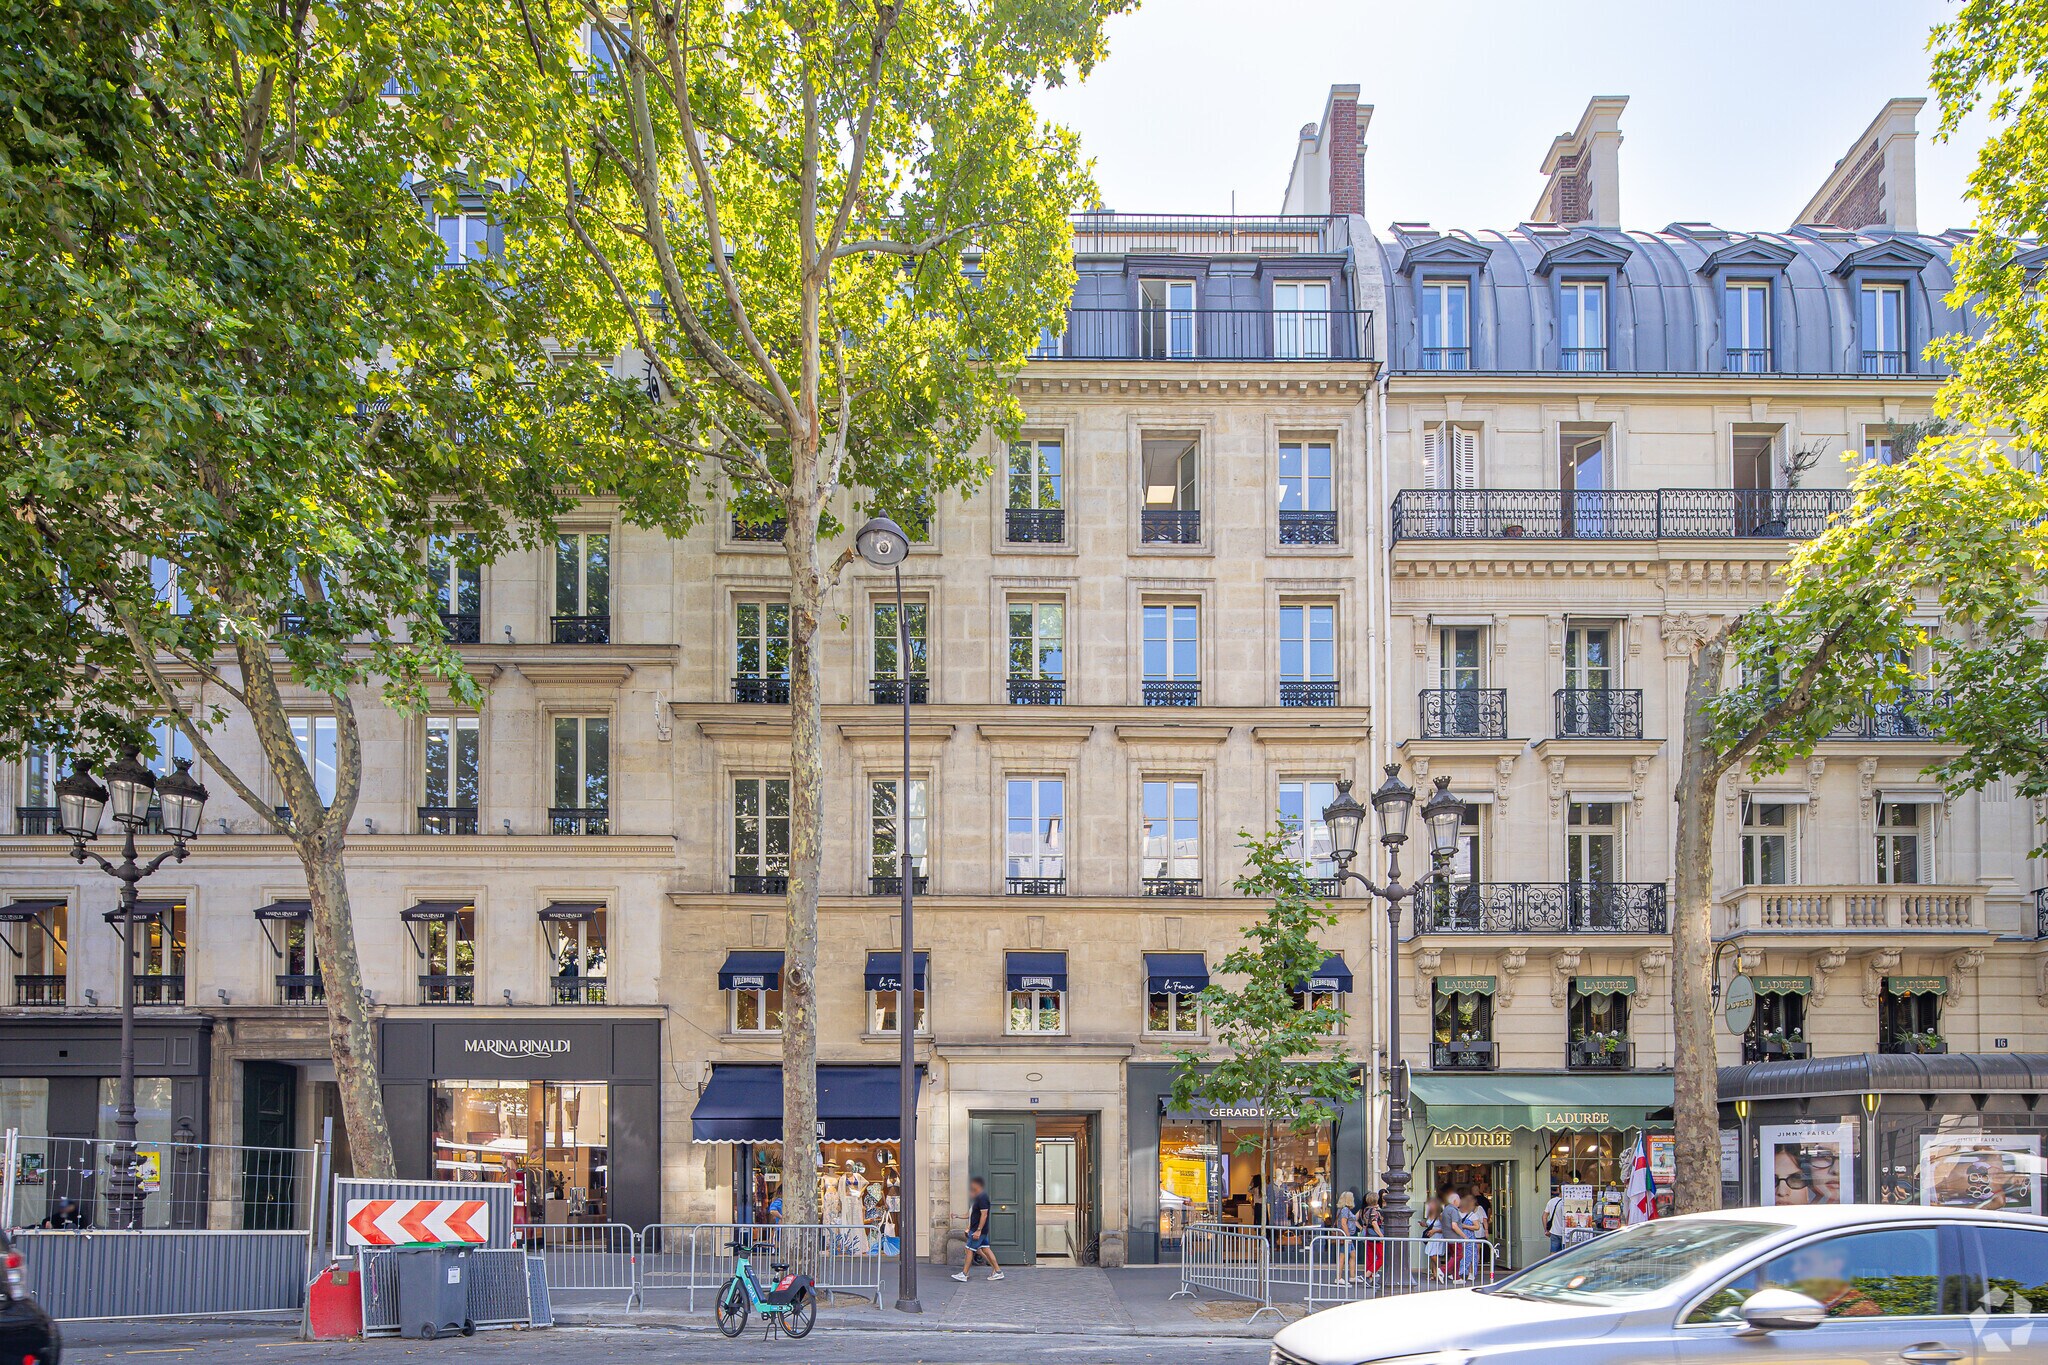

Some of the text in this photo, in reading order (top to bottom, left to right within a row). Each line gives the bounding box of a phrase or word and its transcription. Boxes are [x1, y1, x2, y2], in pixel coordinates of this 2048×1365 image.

[1172, 981, 1195, 991] Femme
[1997, 1039, 2006, 1048] 16
[464, 1039, 571, 1058] MARINA RINALDI
[1209, 1108, 1258, 1117] GERARD
